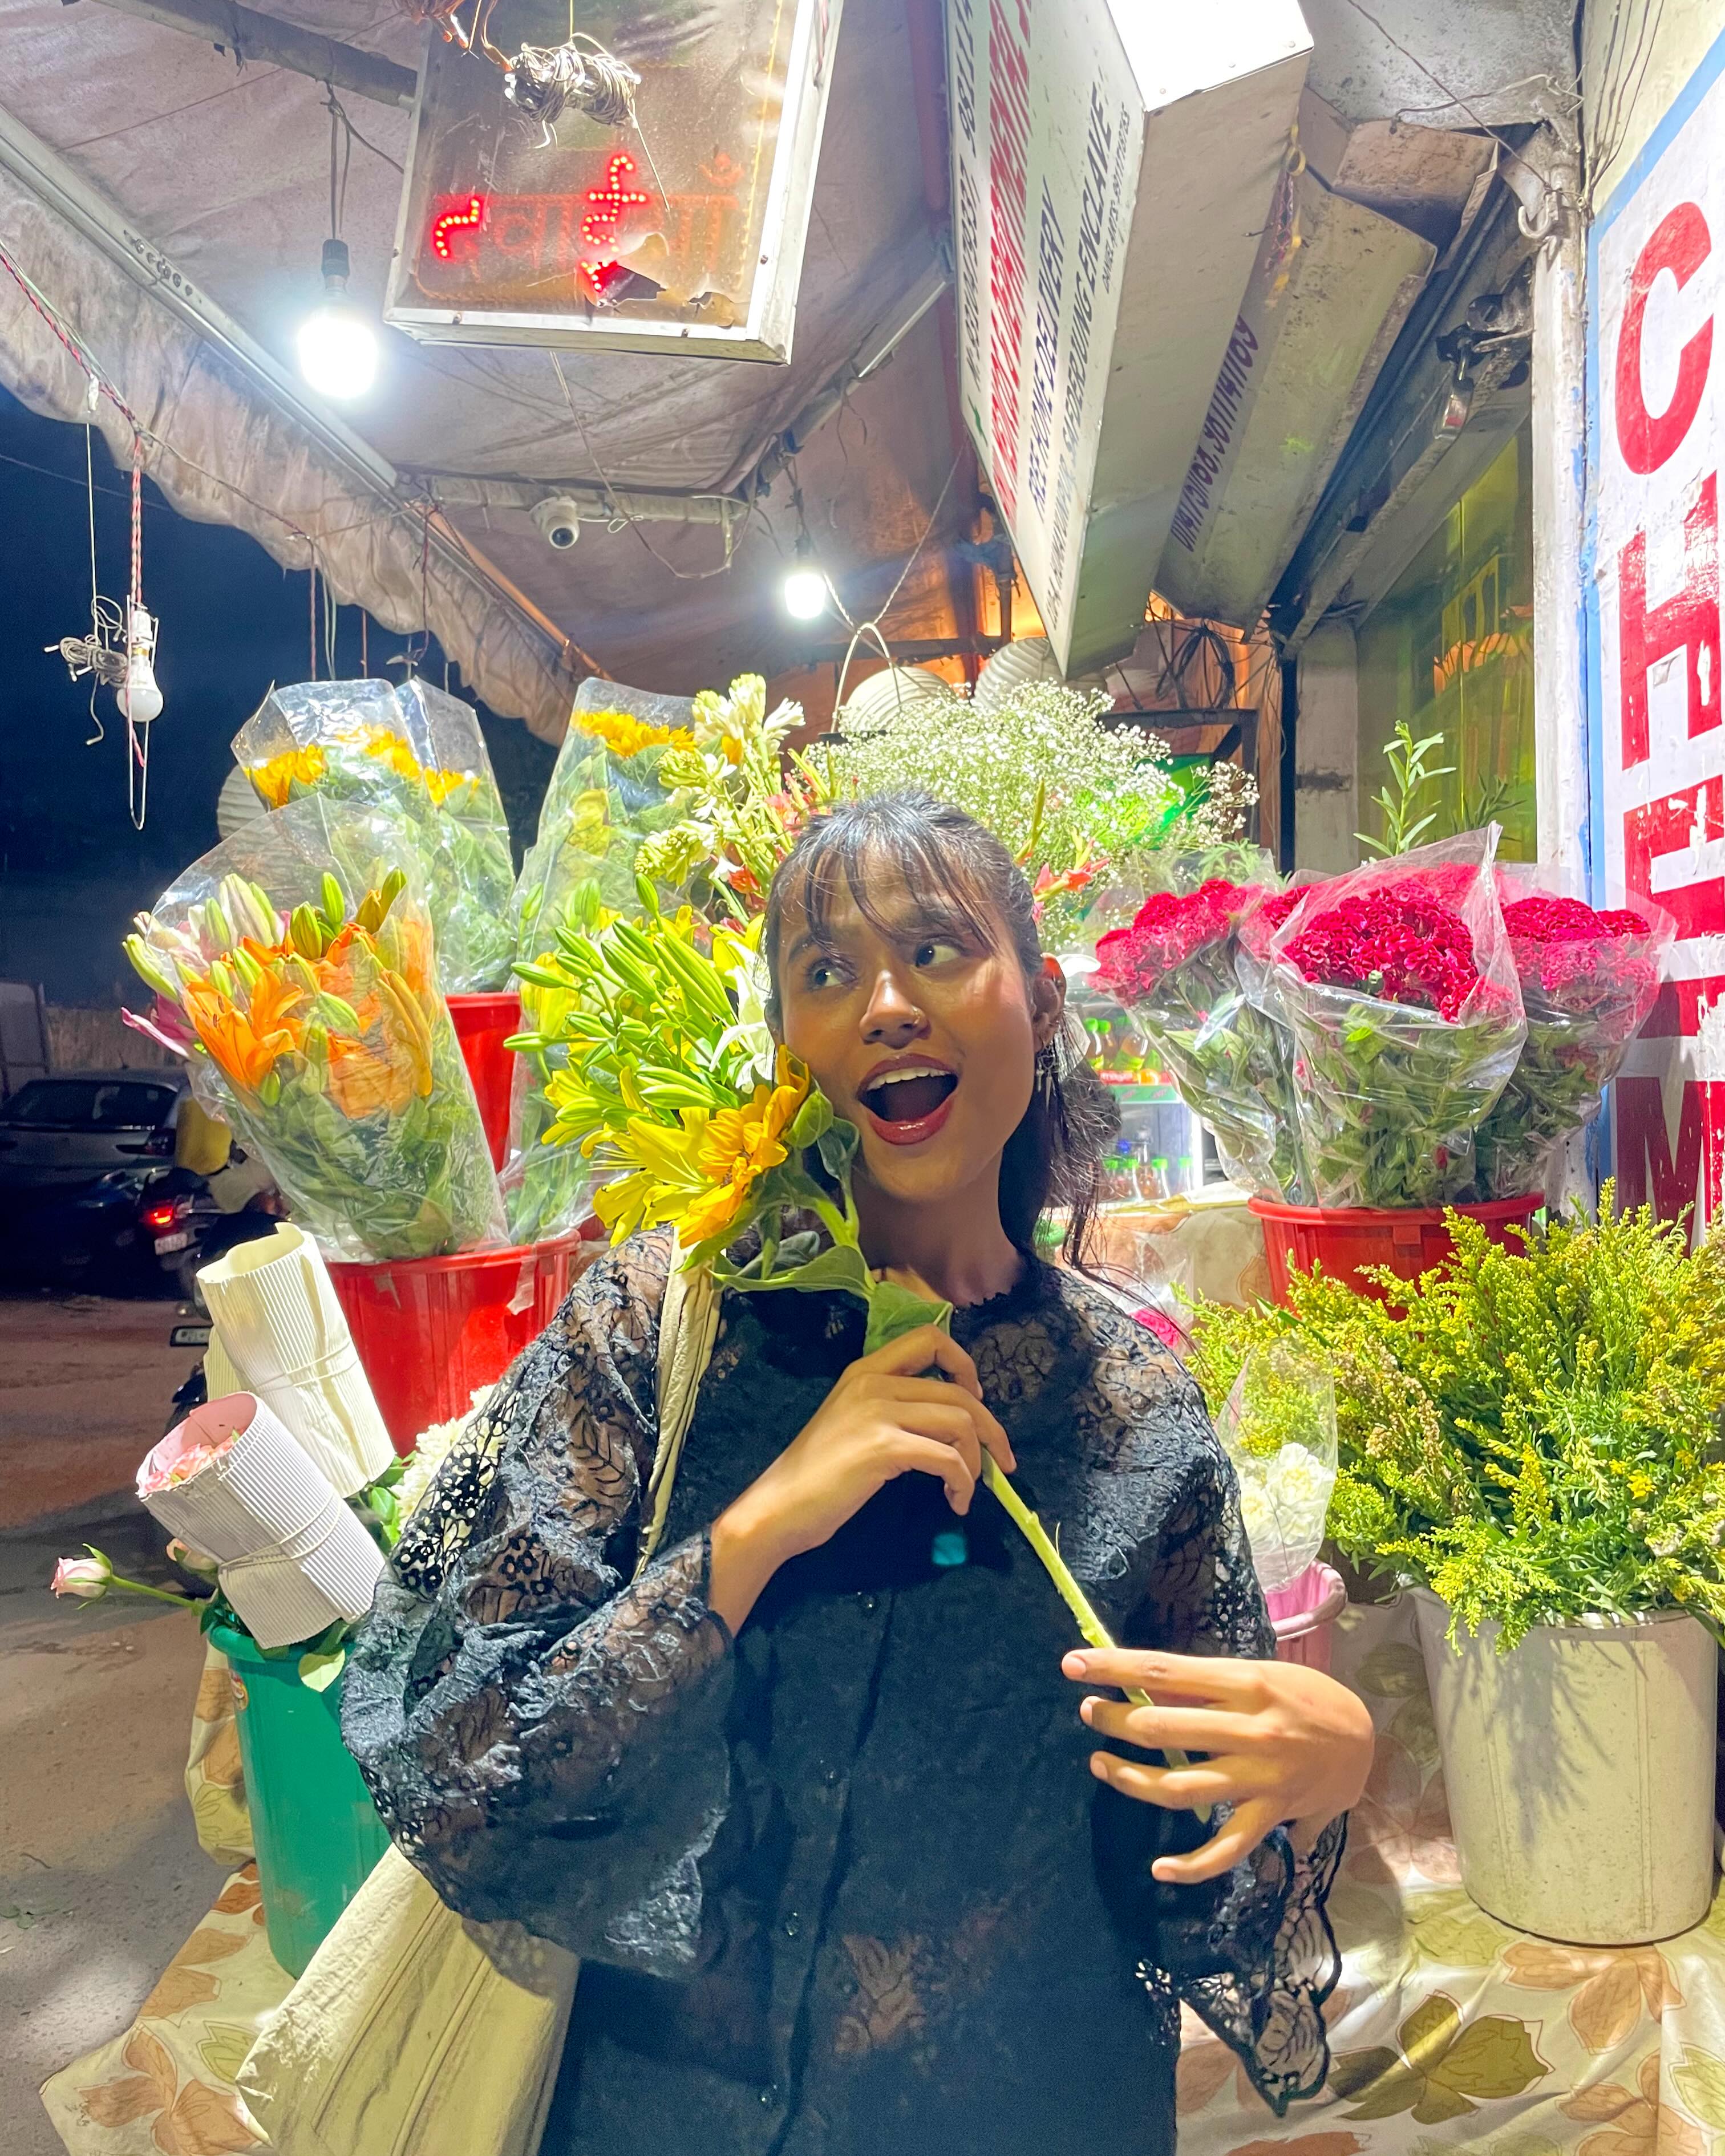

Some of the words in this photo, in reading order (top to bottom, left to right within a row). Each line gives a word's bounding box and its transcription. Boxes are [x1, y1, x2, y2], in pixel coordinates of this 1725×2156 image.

[1035, 175, 1064, 392] DELIVERY
[1062, 271, 1092, 468] SAFDERJUNG
[1078, 82, 1111, 295] ENCLAVE
[1102, 239, 1114, 294] DANIEL
[990, 310, 1020, 391] &
[990, 335, 1020, 494] MEDICOS
[1031, 358, 1052, 468] HOME
[1028, 438, 1046, 523] FREE
